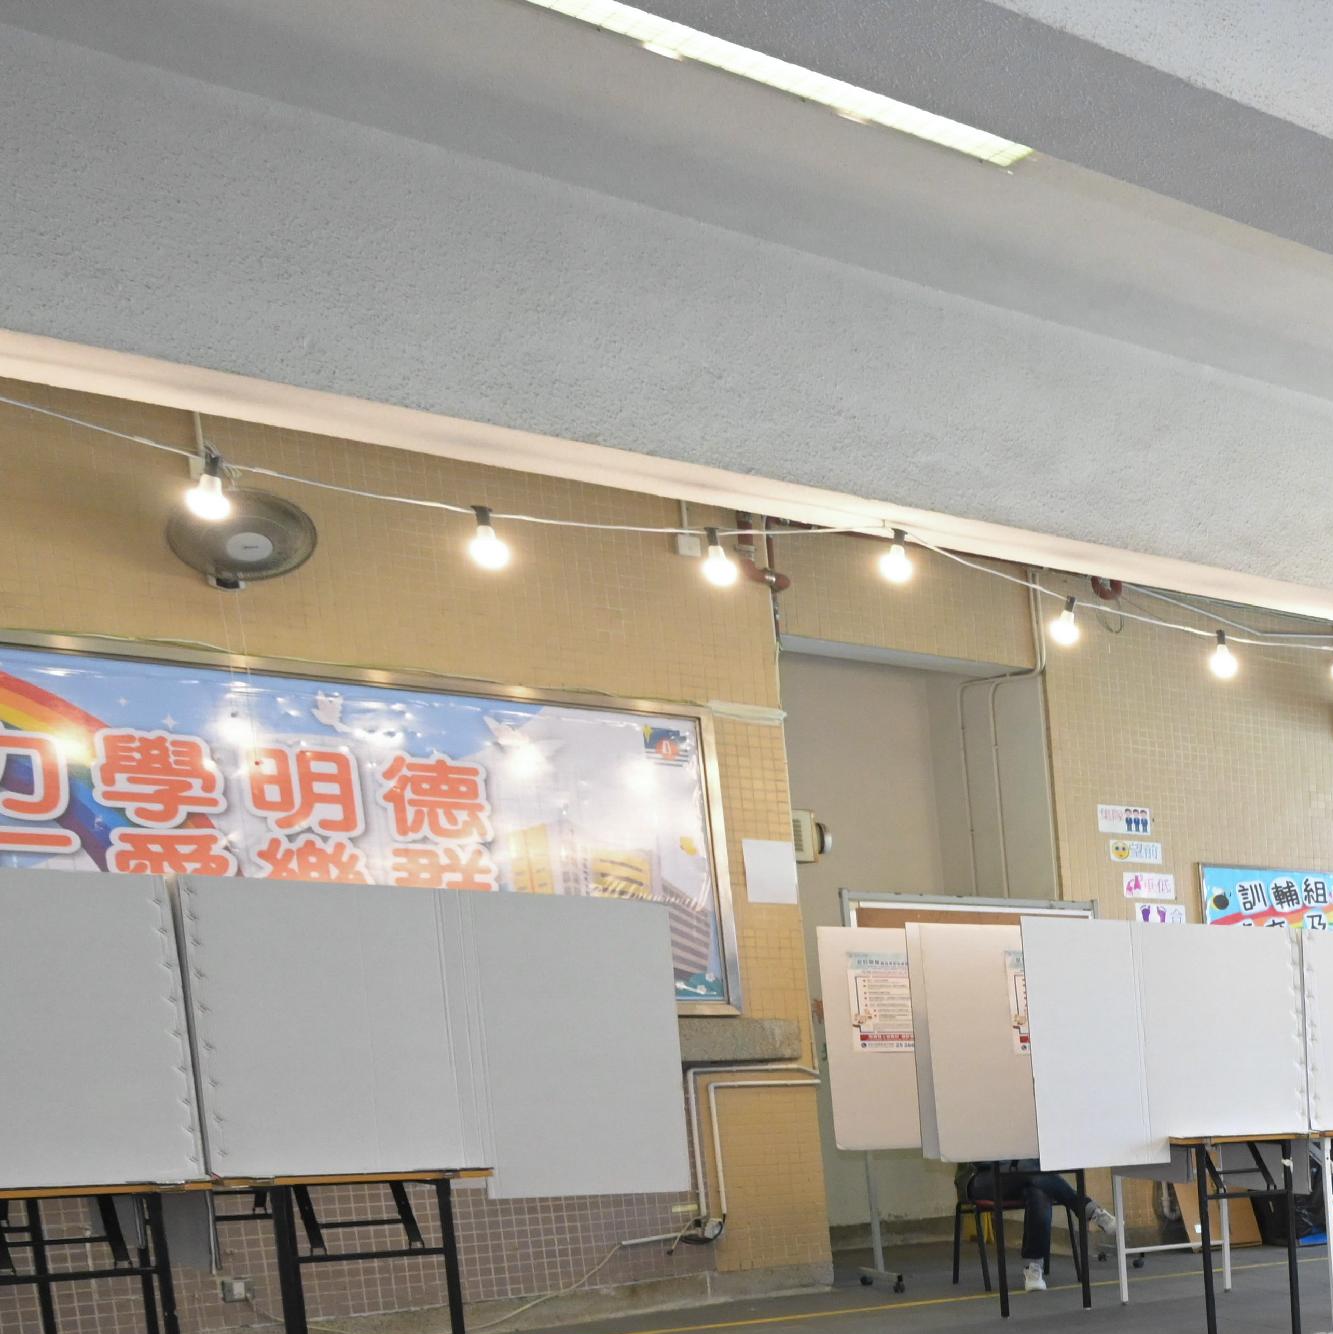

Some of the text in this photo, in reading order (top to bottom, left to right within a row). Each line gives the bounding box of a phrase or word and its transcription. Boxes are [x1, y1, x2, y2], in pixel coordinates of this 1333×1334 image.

[0, 829, 492, 891] 愛樂群
[1238, 879, 1328, 911] 訓輔組
